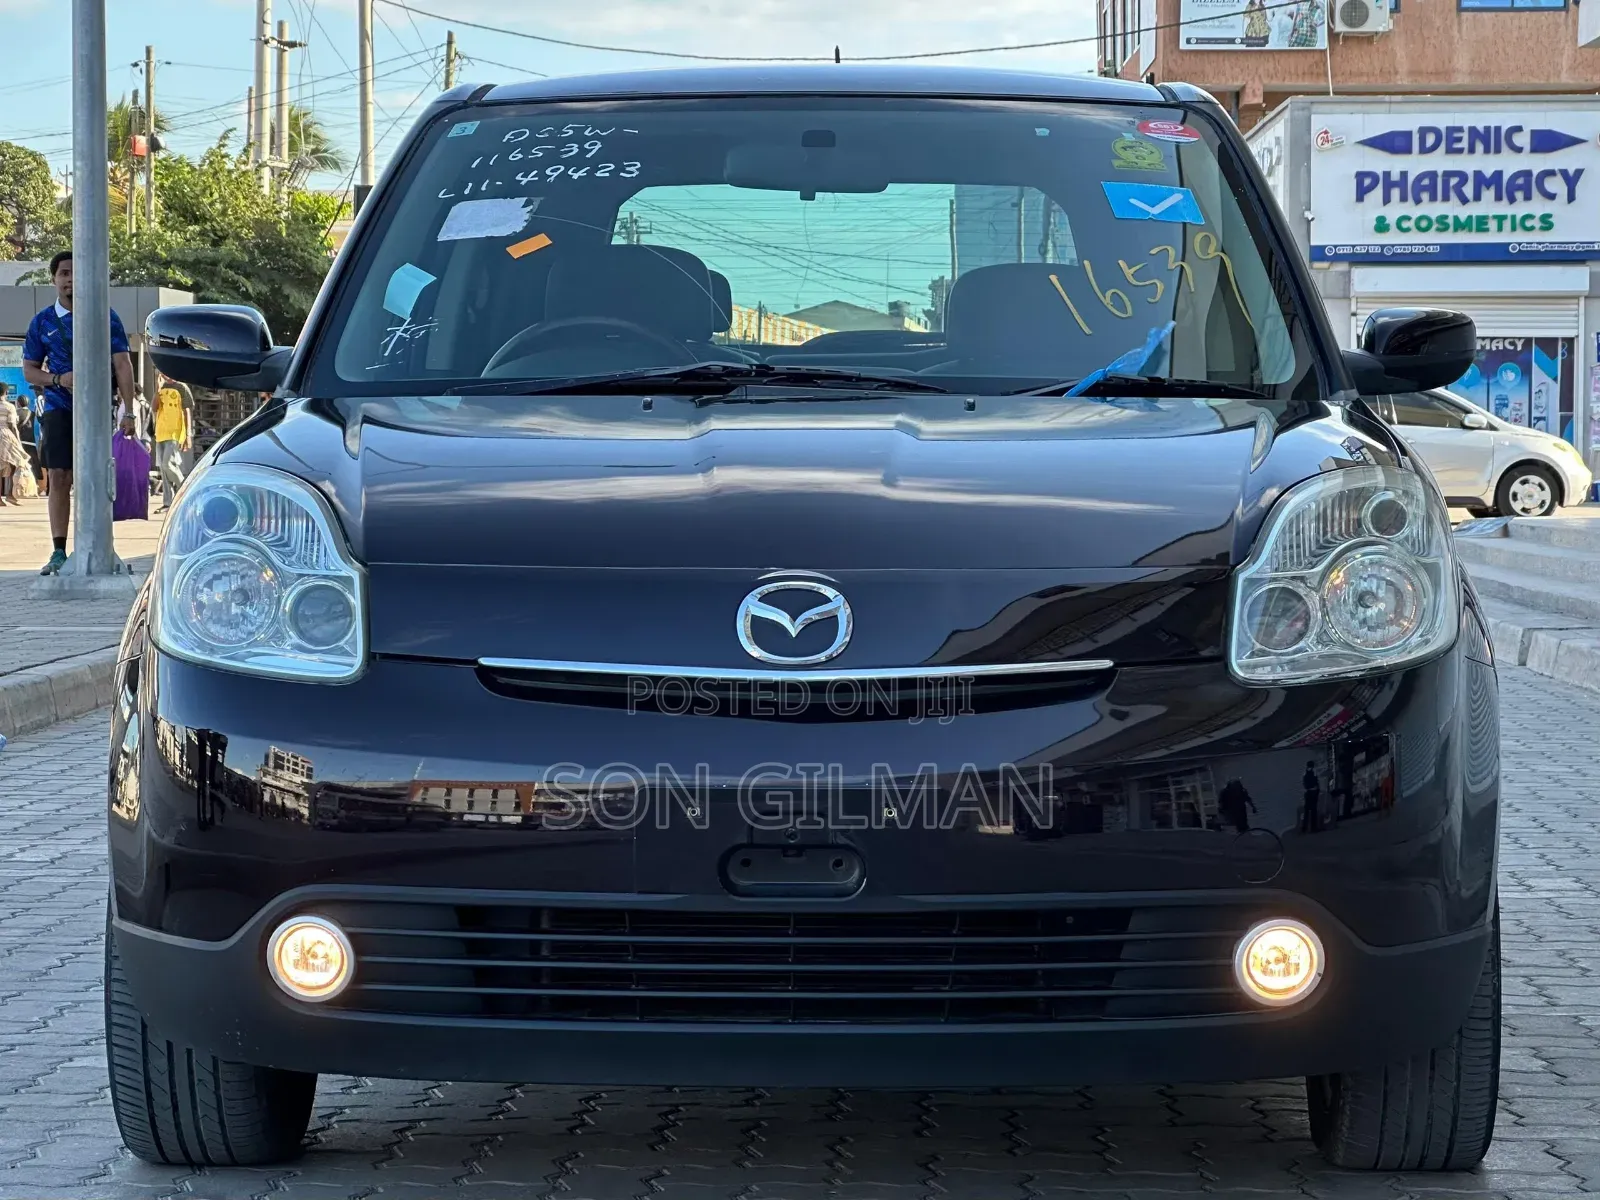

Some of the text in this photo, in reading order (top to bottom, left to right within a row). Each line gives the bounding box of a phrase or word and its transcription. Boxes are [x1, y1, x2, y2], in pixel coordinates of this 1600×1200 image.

[1417, 125, 1524, 155] DENIC
[1355, 168, 1585, 206] PHARMACY
[1374, 213, 1555, 234] & COSMETICS
[1049, 232, 1257, 336] 16539
